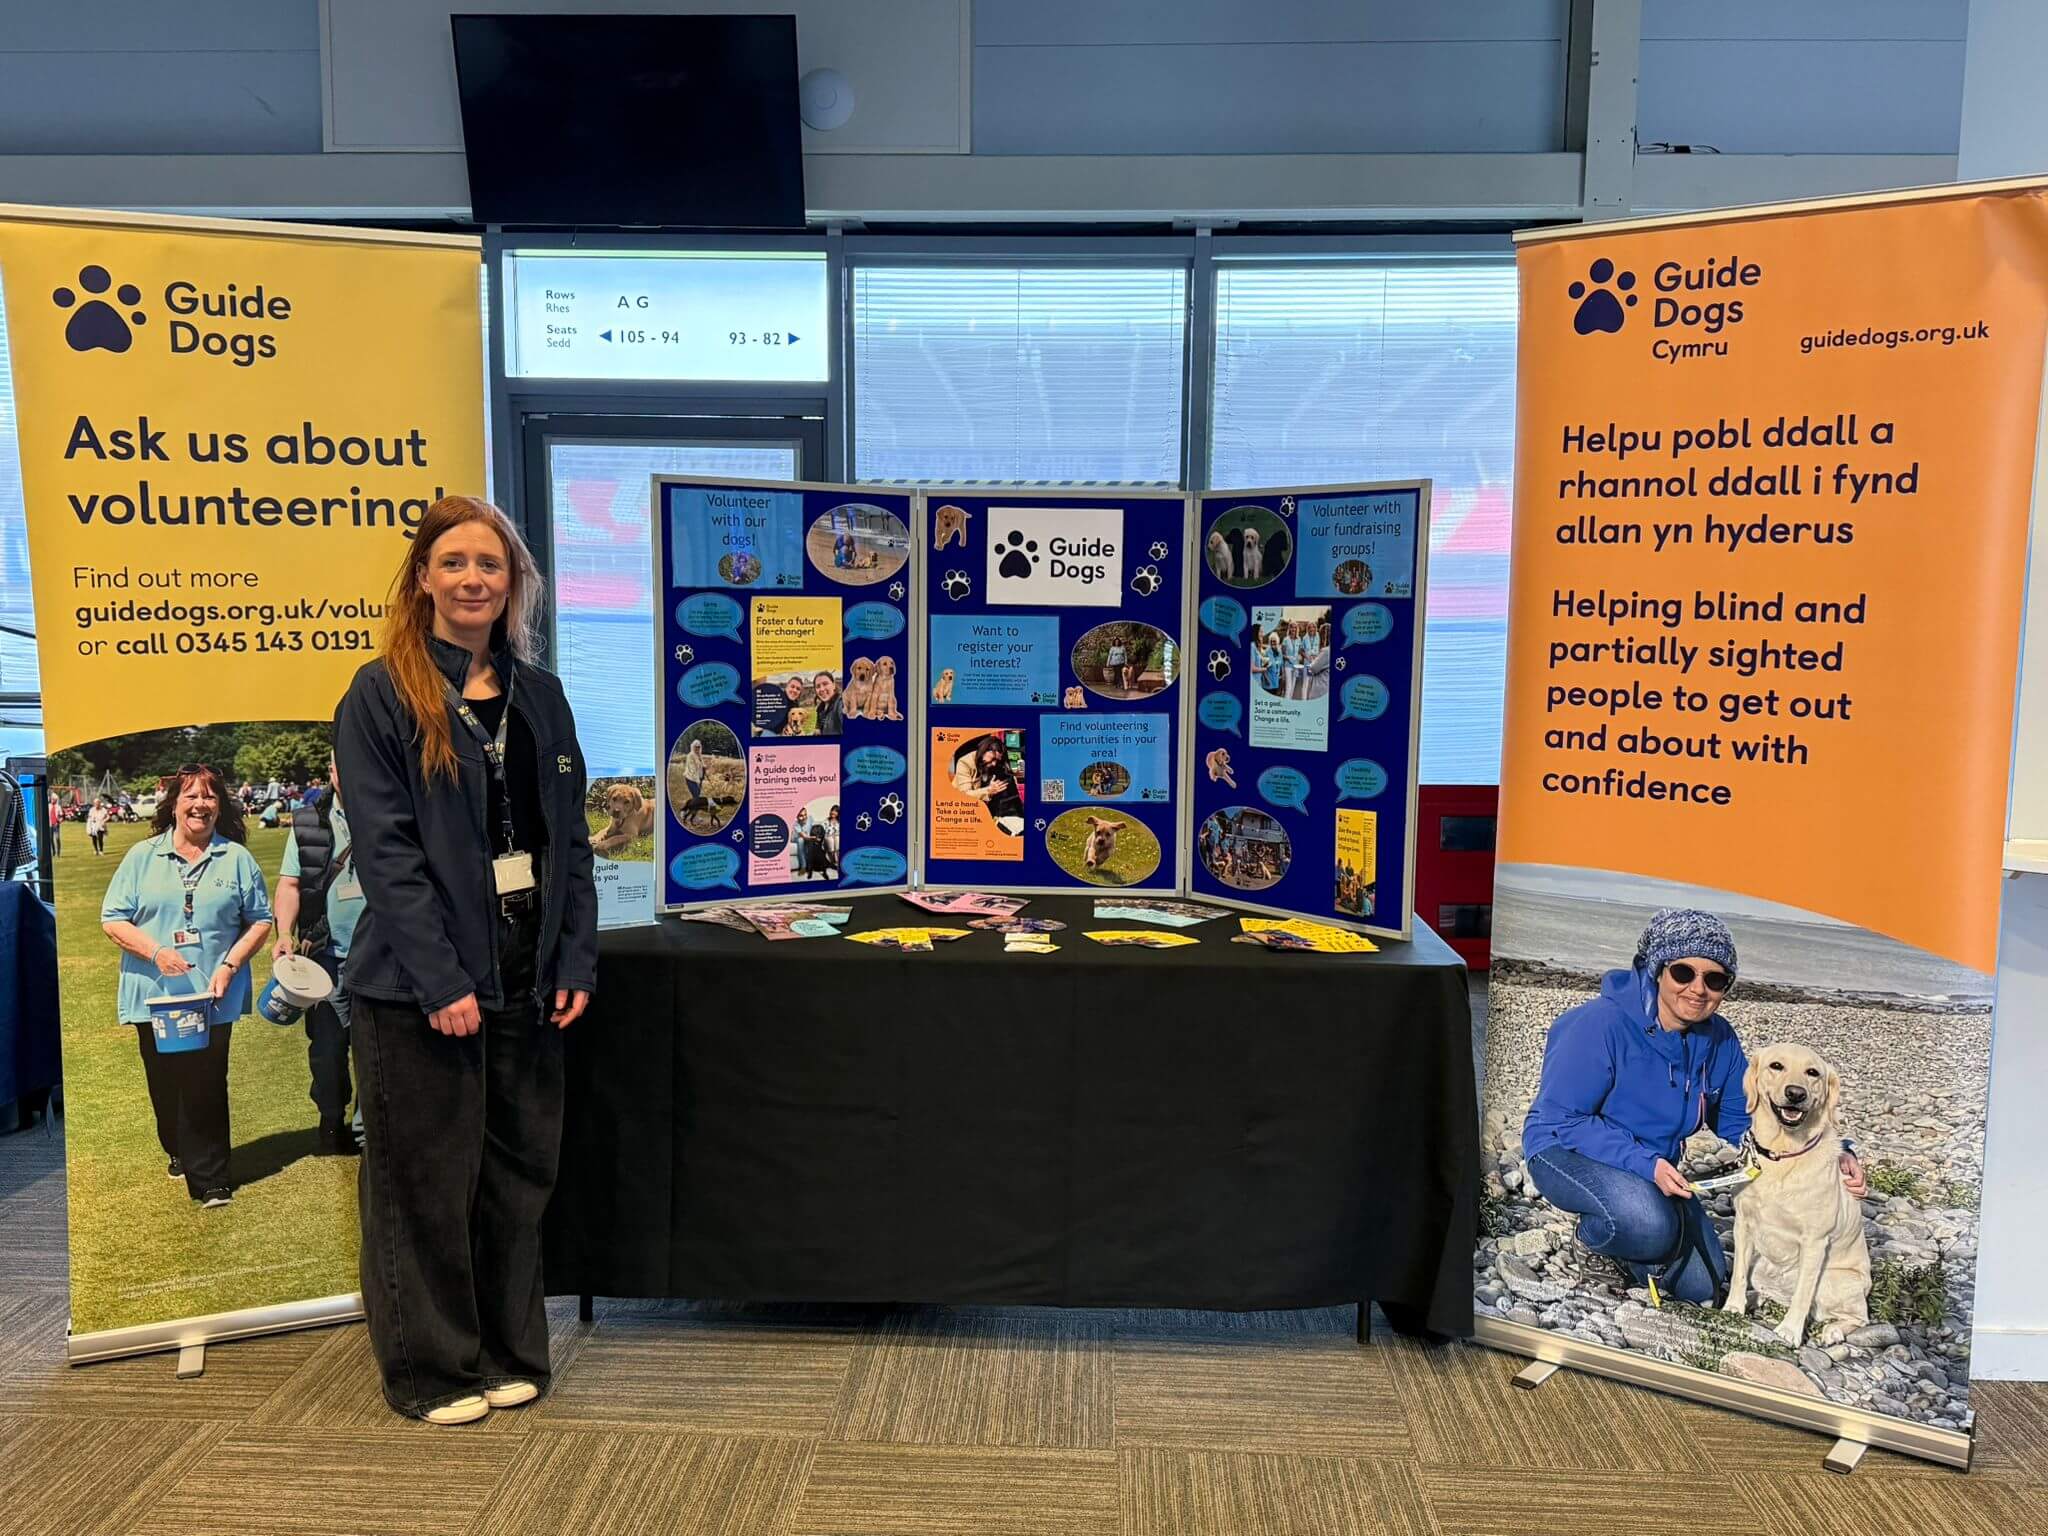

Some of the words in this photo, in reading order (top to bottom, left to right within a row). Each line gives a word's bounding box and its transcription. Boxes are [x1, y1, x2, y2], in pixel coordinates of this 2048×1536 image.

[1654, 255, 1761, 292] Guide
[164, 281, 292, 320] Guide
[546, 290, 575, 300] Rows
[546, 303, 570, 313] Rhes
[617, 296, 629, 308] A
[637, 296, 649, 309] G
[1654, 297, 1744, 333] Dogs
[546, 324, 577, 335] Seats
[546, 337, 571, 348] Sedd
[621, 330, 645, 343] 105
[662, 330, 679, 344] 94
[729, 332, 746, 345] 93
[763, 332, 780, 345] 82
[1799, 320, 1989, 354] guidedogs.org.uk
[169, 321, 277, 368] Dogs
[1651, 338, 1729, 365] Cymru
[64, 415, 170, 462] Ask
[189, 433, 249, 464] us
[266, 421, 428, 467] about
[1561, 421, 1661, 460] Helpu
[1672, 418, 1751, 458] pobl
[1762, 416, 1858, 447] ddall
[1870, 421, 1894, 445] a
[1559, 468, 1697, 500] rhannol
[1708, 466, 1801, 497] ddall
[1812, 466, 1821, 495] i
[1832, 462, 1919, 503] fynd
[707, 494, 771, 508] Volunteer
[1313, 503, 1369, 516] Volunteer
[1374, 501, 1401, 514] with
[712, 514, 740, 527] with
[745, 517, 766, 528] our
[1311, 525, 1330, 537] our
[1334, 522, 1401, 537] fundraising
[1555, 515, 1642, 546] allan
[1653, 520, 1694, 552] yn
[1704, 513, 1854, 550] hyderus
[722, 534, 756, 548] dogs!
[1049, 538, 1115, 557] Guide
[1332, 541, 1375, 558] groups!
[73, 567, 129, 589] Find
[137, 569, 182, 589] out
[190, 570, 259, 588] more
[1050, 560, 1105, 584] Dogs
[1552, 589, 1682, 628] Helping
[1695, 590, 1784, 623] blind
[1795, 592, 1866, 625] and
[756, 617, 785, 625] Foster
[796, 617, 824, 625] future
[756, 627, 815, 638] life-changer!
[972, 625, 1002, 637] Want
[1007, 626, 1019, 637] to
[78, 637, 108, 656] or
[116, 633, 168, 655] call
[175, 632, 247, 654] 0345
[255, 631, 303, 652] 143
[311, 630, 374, 651] 0191
[958, 642, 1002, 654] register
[1007, 644, 1033, 654] your
[970, 657, 1021, 668] interest?
[1549, 636, 1697, 673] partially
[1708, 639, 1844, 676] sighted
[1546, 679, 1663, 717] people
[1673, 684, 1708, 713] to
[1719, 687, 1780, 722] get
[1789, 692, 1852, 720] out
[1254, 715, 1275, 724] Change
[1060, 721, 1081, 731] Find
[1085, 721, 1149, 733] volunteering
[1051, 735, 1119, 746] opportunities
[1123, 736, 1132, 744] in
[1135, 736, 1157, 746] your
[1544, 723, 1606, 752] and
[1617, 727, 1720, 759] about
[1731, 735, 1808, 765] with
[1091, 748, 1117, 758] area!
[755, 766, 761, 774] A
[763, 765, 787, 776] guide
[789, 764, 805, 774] dog
[808, 763, 815, 772] in
[755, 775, 789, 785] training
[792, 774, 816, 783] needs
[819, 774, 836, 783] you!
[1542, 765, 1732, 806] confidence
[936, 816, 962, 824] Change
[596, 863, 618, 873] guide
[604, 874, 618, 883] you
